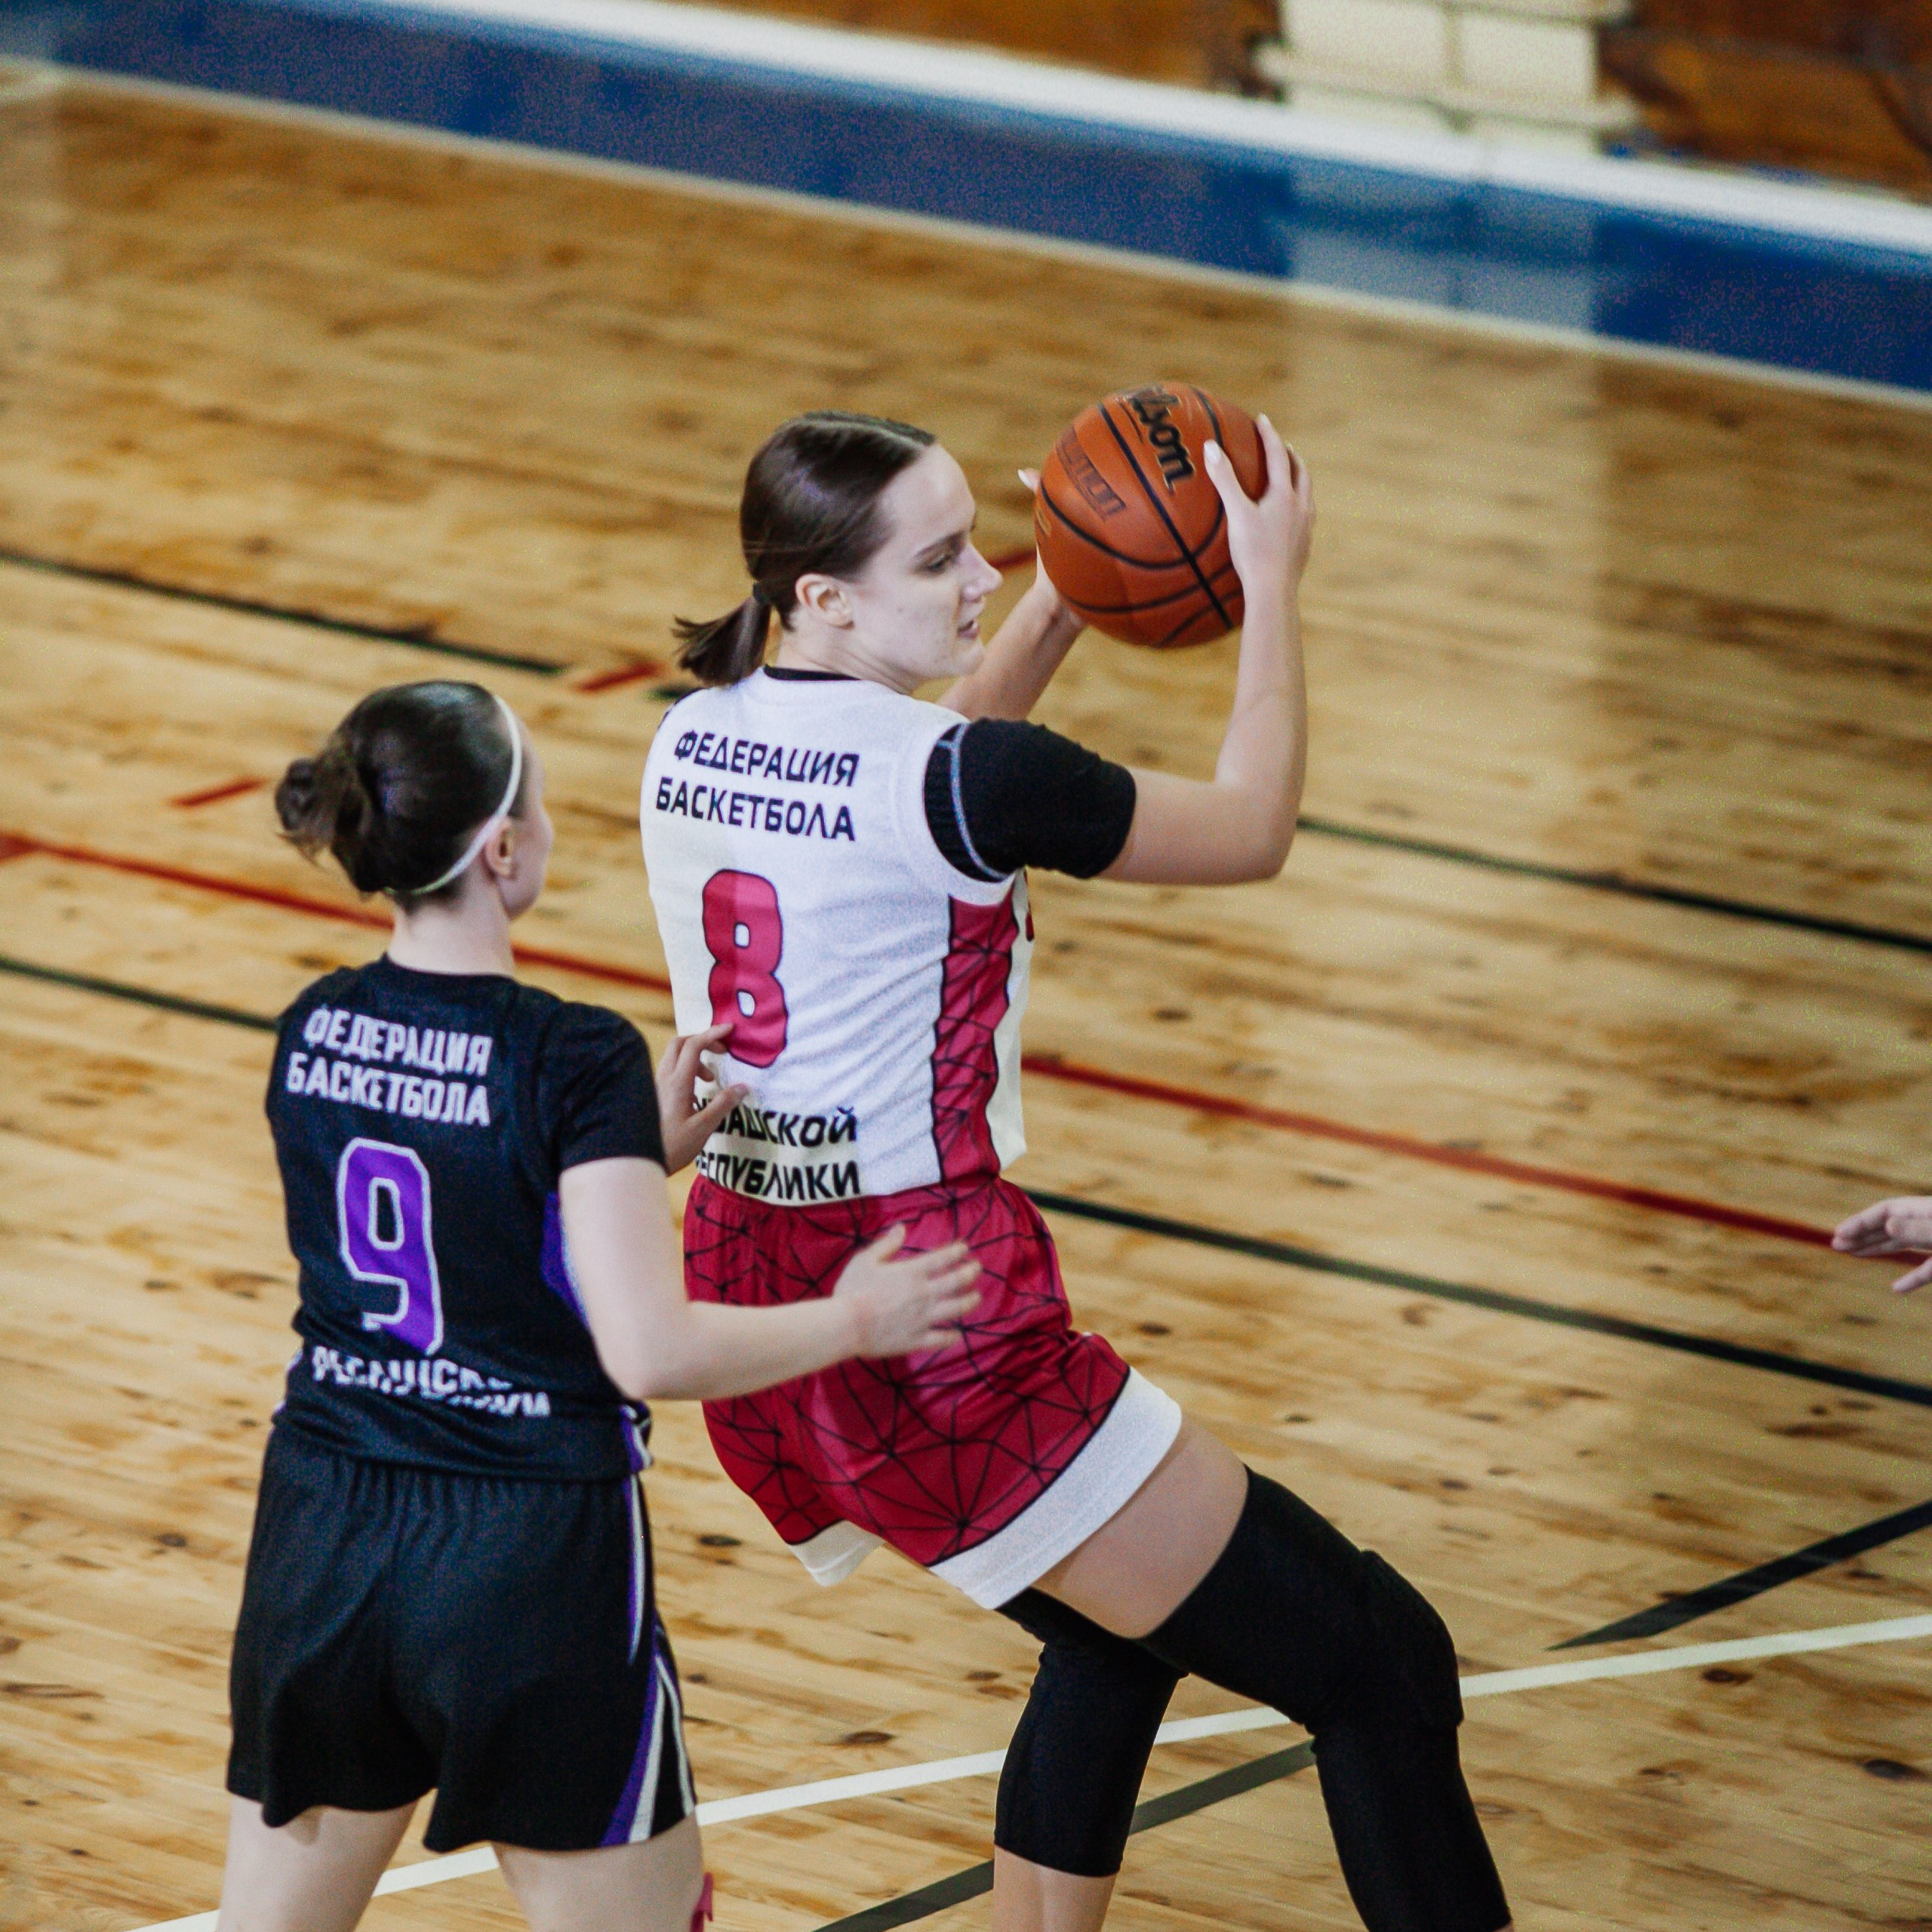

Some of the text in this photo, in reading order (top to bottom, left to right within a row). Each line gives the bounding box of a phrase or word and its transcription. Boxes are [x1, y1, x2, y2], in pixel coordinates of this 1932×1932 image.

[674, 730, 860, 787] ФЕДЕРАЦИЯ
[656, 777, 856, 841] БАСКЕТБОЛА
[702, 869, 789, 1068] 8
[303, 1004, 493, 1077] ФЕДЕРАЦИЯ
[285, 1052, 491, 1128] БАСКЕТБОЛА
[336, 1137, 445, 1356] 9
